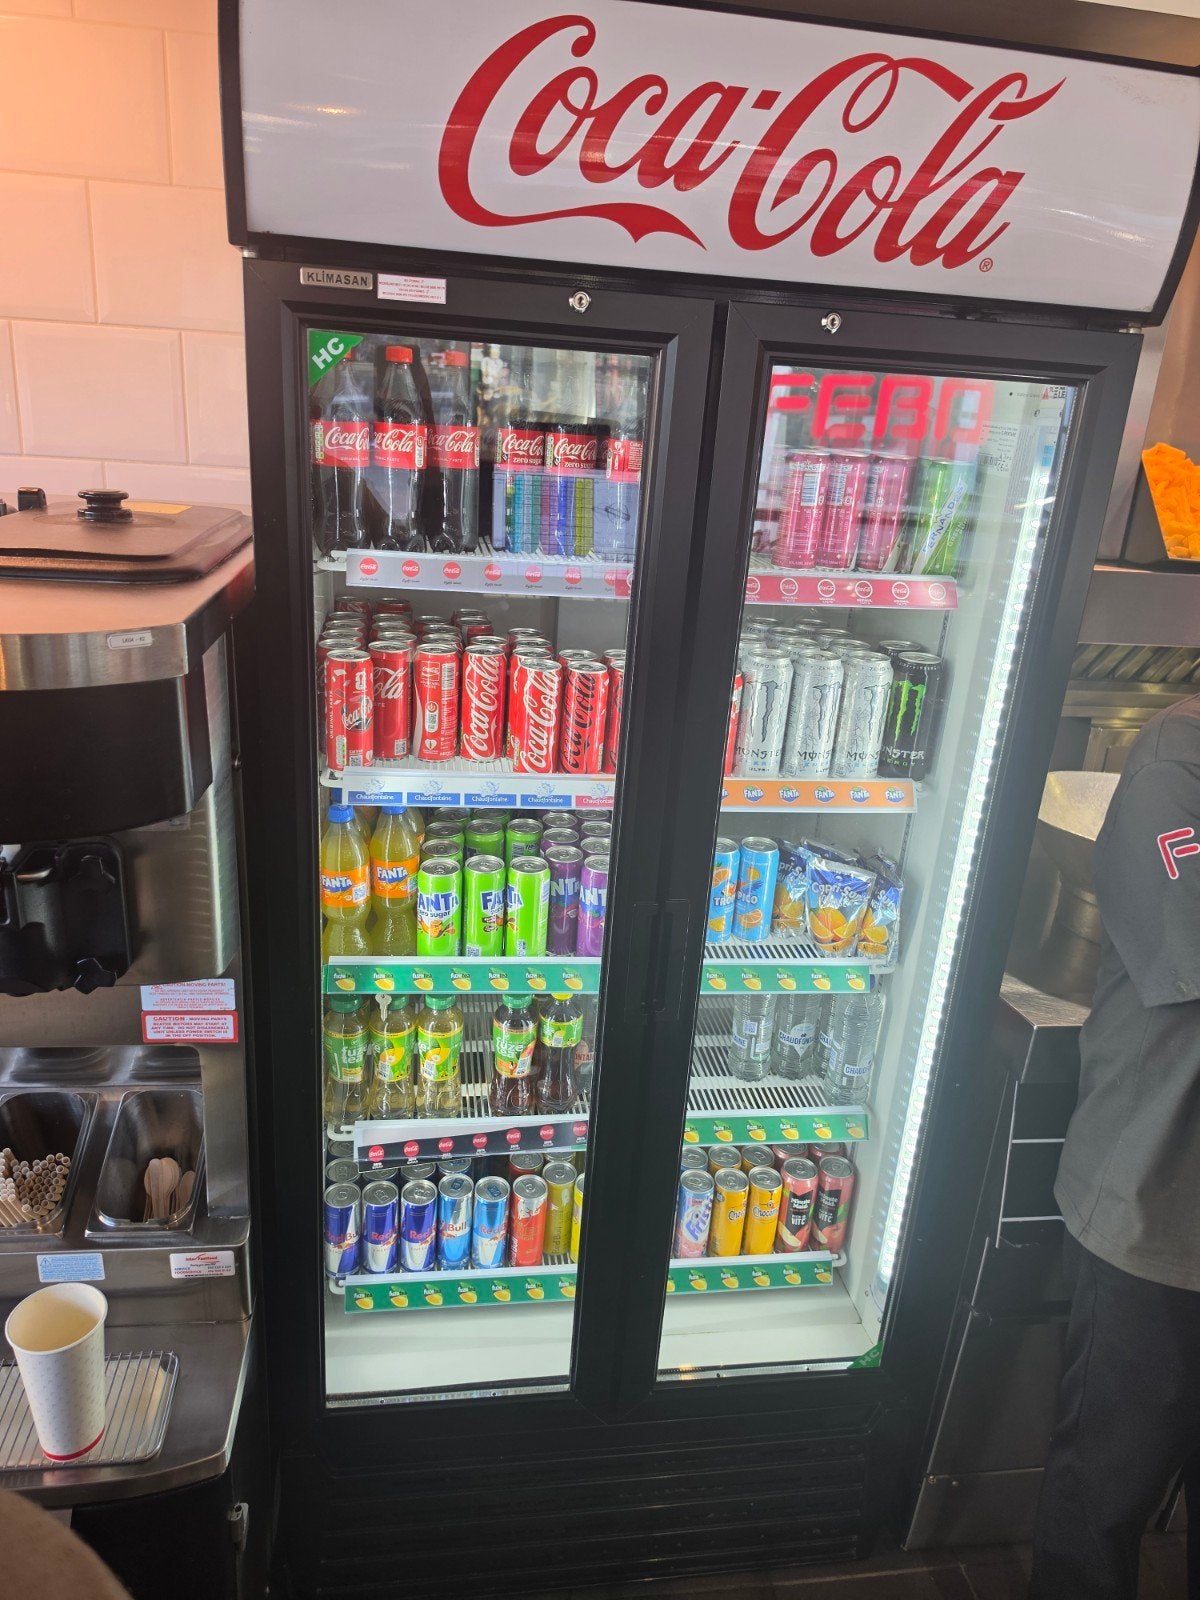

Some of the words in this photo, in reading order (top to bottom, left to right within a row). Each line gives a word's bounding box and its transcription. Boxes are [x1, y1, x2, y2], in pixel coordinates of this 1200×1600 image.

[438, 14, 1067, 270] Coca-Cola
[306, 270, 369, 287] KLİMASAN
[311, 336, 345, 370] HC
[463, 655, 500, 762] Coca-Cola
[520, 669, 558, 774] Coca-Cola
[744, 789, 764, 798] FANTA
[779, 790, 799, 798] FANTA
[814, 790, 835, 798] FANTA
[850, 790, 870, 798] FANTA
[885, 791, 905, 799] FANTA
[377, 866, 408, 880] FANTA
[322, 875, 353, 889] FANTA
[418, 892, 459, 912] ANTA
[447, 1221, 467, 1232] Bull
